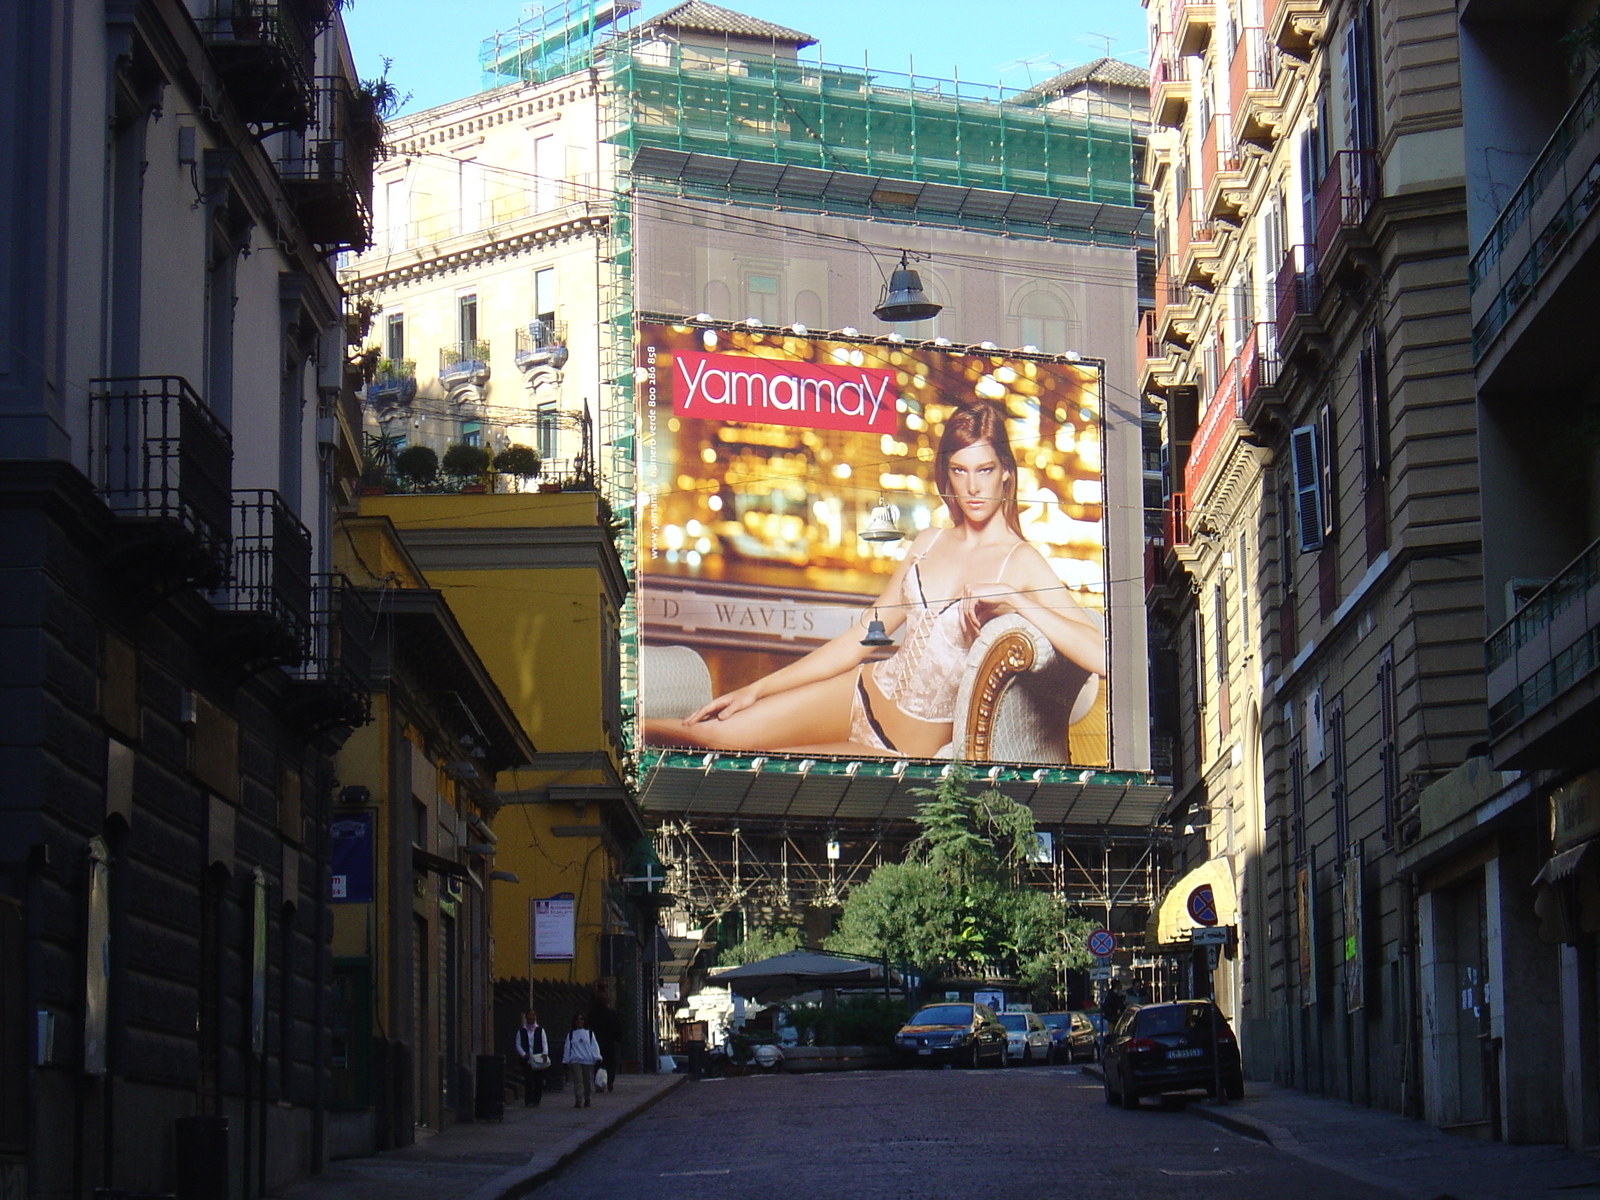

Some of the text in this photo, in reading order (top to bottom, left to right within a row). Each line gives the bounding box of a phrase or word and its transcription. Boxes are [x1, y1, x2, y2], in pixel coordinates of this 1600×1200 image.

[647, 345, 657, 365] 858
[648, 366, 656, 386] 286
[648, 387, 657, 408] 800
[648, 409, 657, 437] verde
[650, 441, 658, 478] numero
[715, 603, 815, 632] WAVES
